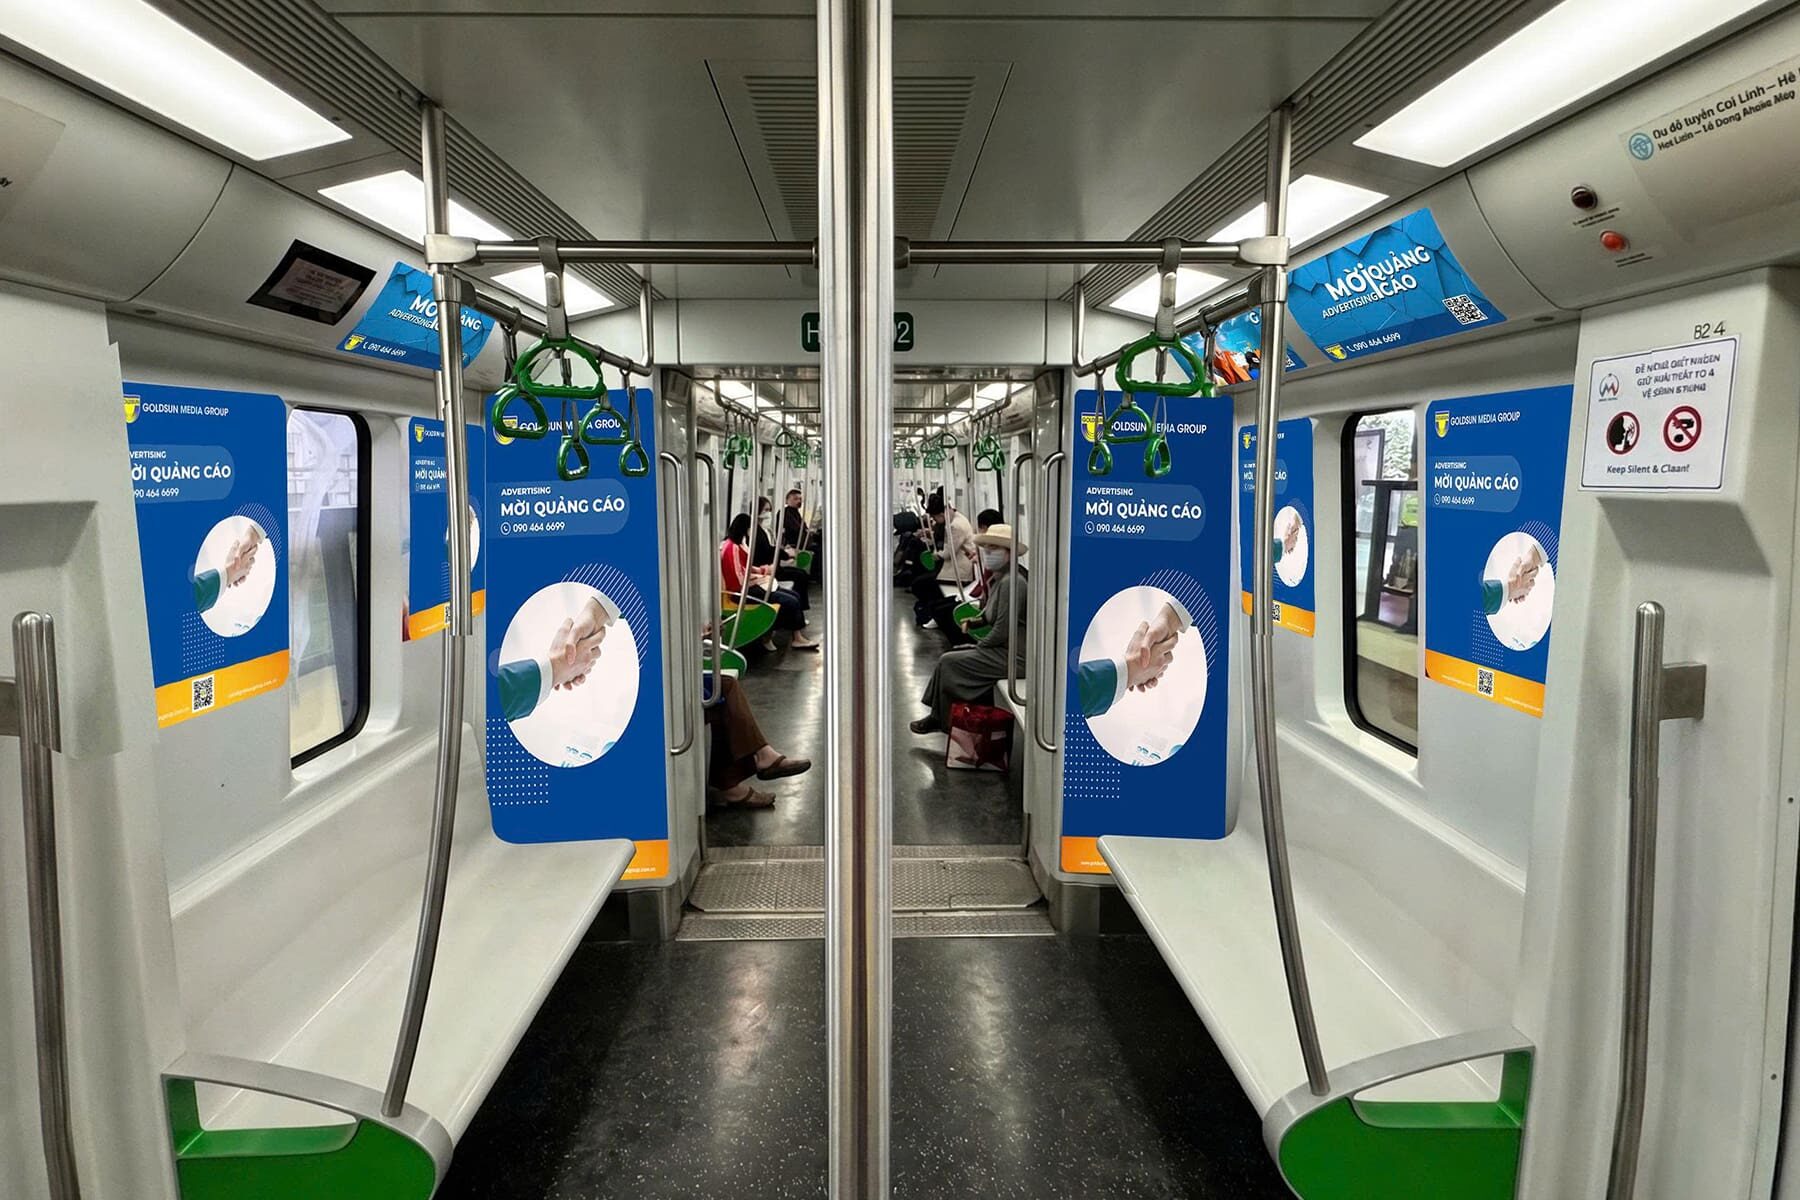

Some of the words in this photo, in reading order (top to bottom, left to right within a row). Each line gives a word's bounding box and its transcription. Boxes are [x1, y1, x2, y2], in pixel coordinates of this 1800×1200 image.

[1368, 246, 1430, 280] QUẢNG
[1380, 274, 1417, 297] CÁO
[1322, 292, 1378, 318] ADVERTISING
[388, 309, 432, 328] ADVERTISING
[460, 311, 481, 330] ẢNG
[895, 321, 910, 343] 2
[143, 403, 178, 414] GOLDSUN
[180, 406, 203, 415] MEDIA
[204, 406, 229, 416] GROUP
[594, 419, 621, 428] GROU
[1450, 415, 1477, 426] GOLDSUN
[1478, 414, 1496, 424] MEDIA
[1498, 411, 1521, 422] GROUP
[1111, 421, 1146, 432] OLDSUN
[1156, 423, 1175, 433] EDIA
[1177, 424, 1206, 434] GROUP
[130, 451, 166, 459] VERTISING
[131, 462, 146, 480] ỜI
[150, 461, 200, 482] QUẢNG
[204, 461, 231, 478] CÁO
[1607, 465, 1626, 475] Keep
[1627, 464, 1650, 474] Silent
[1434, 472, 1452, 489] MỜI
[1455, 472, 1492, 491] QUẢNG
[1494, 472, 1519, 490] CÁO
[134, 489, 144, 498] 90
[146, 488, 160, 497] 464
[161, 488, 179, 497] 6699
[501, 487, 551, 497] ADVERTISING
[1086, 487, 1133, 496] ADVERTISING
[501, 499, 530, 517] MỜI
[534, 496, 588, 517] QUẢNG
[593, 495, 625, 512] CÁO
[1441, 496, 1450, 504] 090
[1451, 496, 1460, 504] 464
[1086, 499, 1112, 516] MỜI
[1117, 499, 1168, 519] QUẢNG
[1172, 502, 1202, 519] CÁO
[513, 523, 527, 533] 090
[529, 523, 544, 532] 464
[546, 521, 565, 531] 6699
[1096, 524, 1110, 533] 090
[1112, 524, 1125, 533] 464
[1127, 525, 1145, 534] 6699
